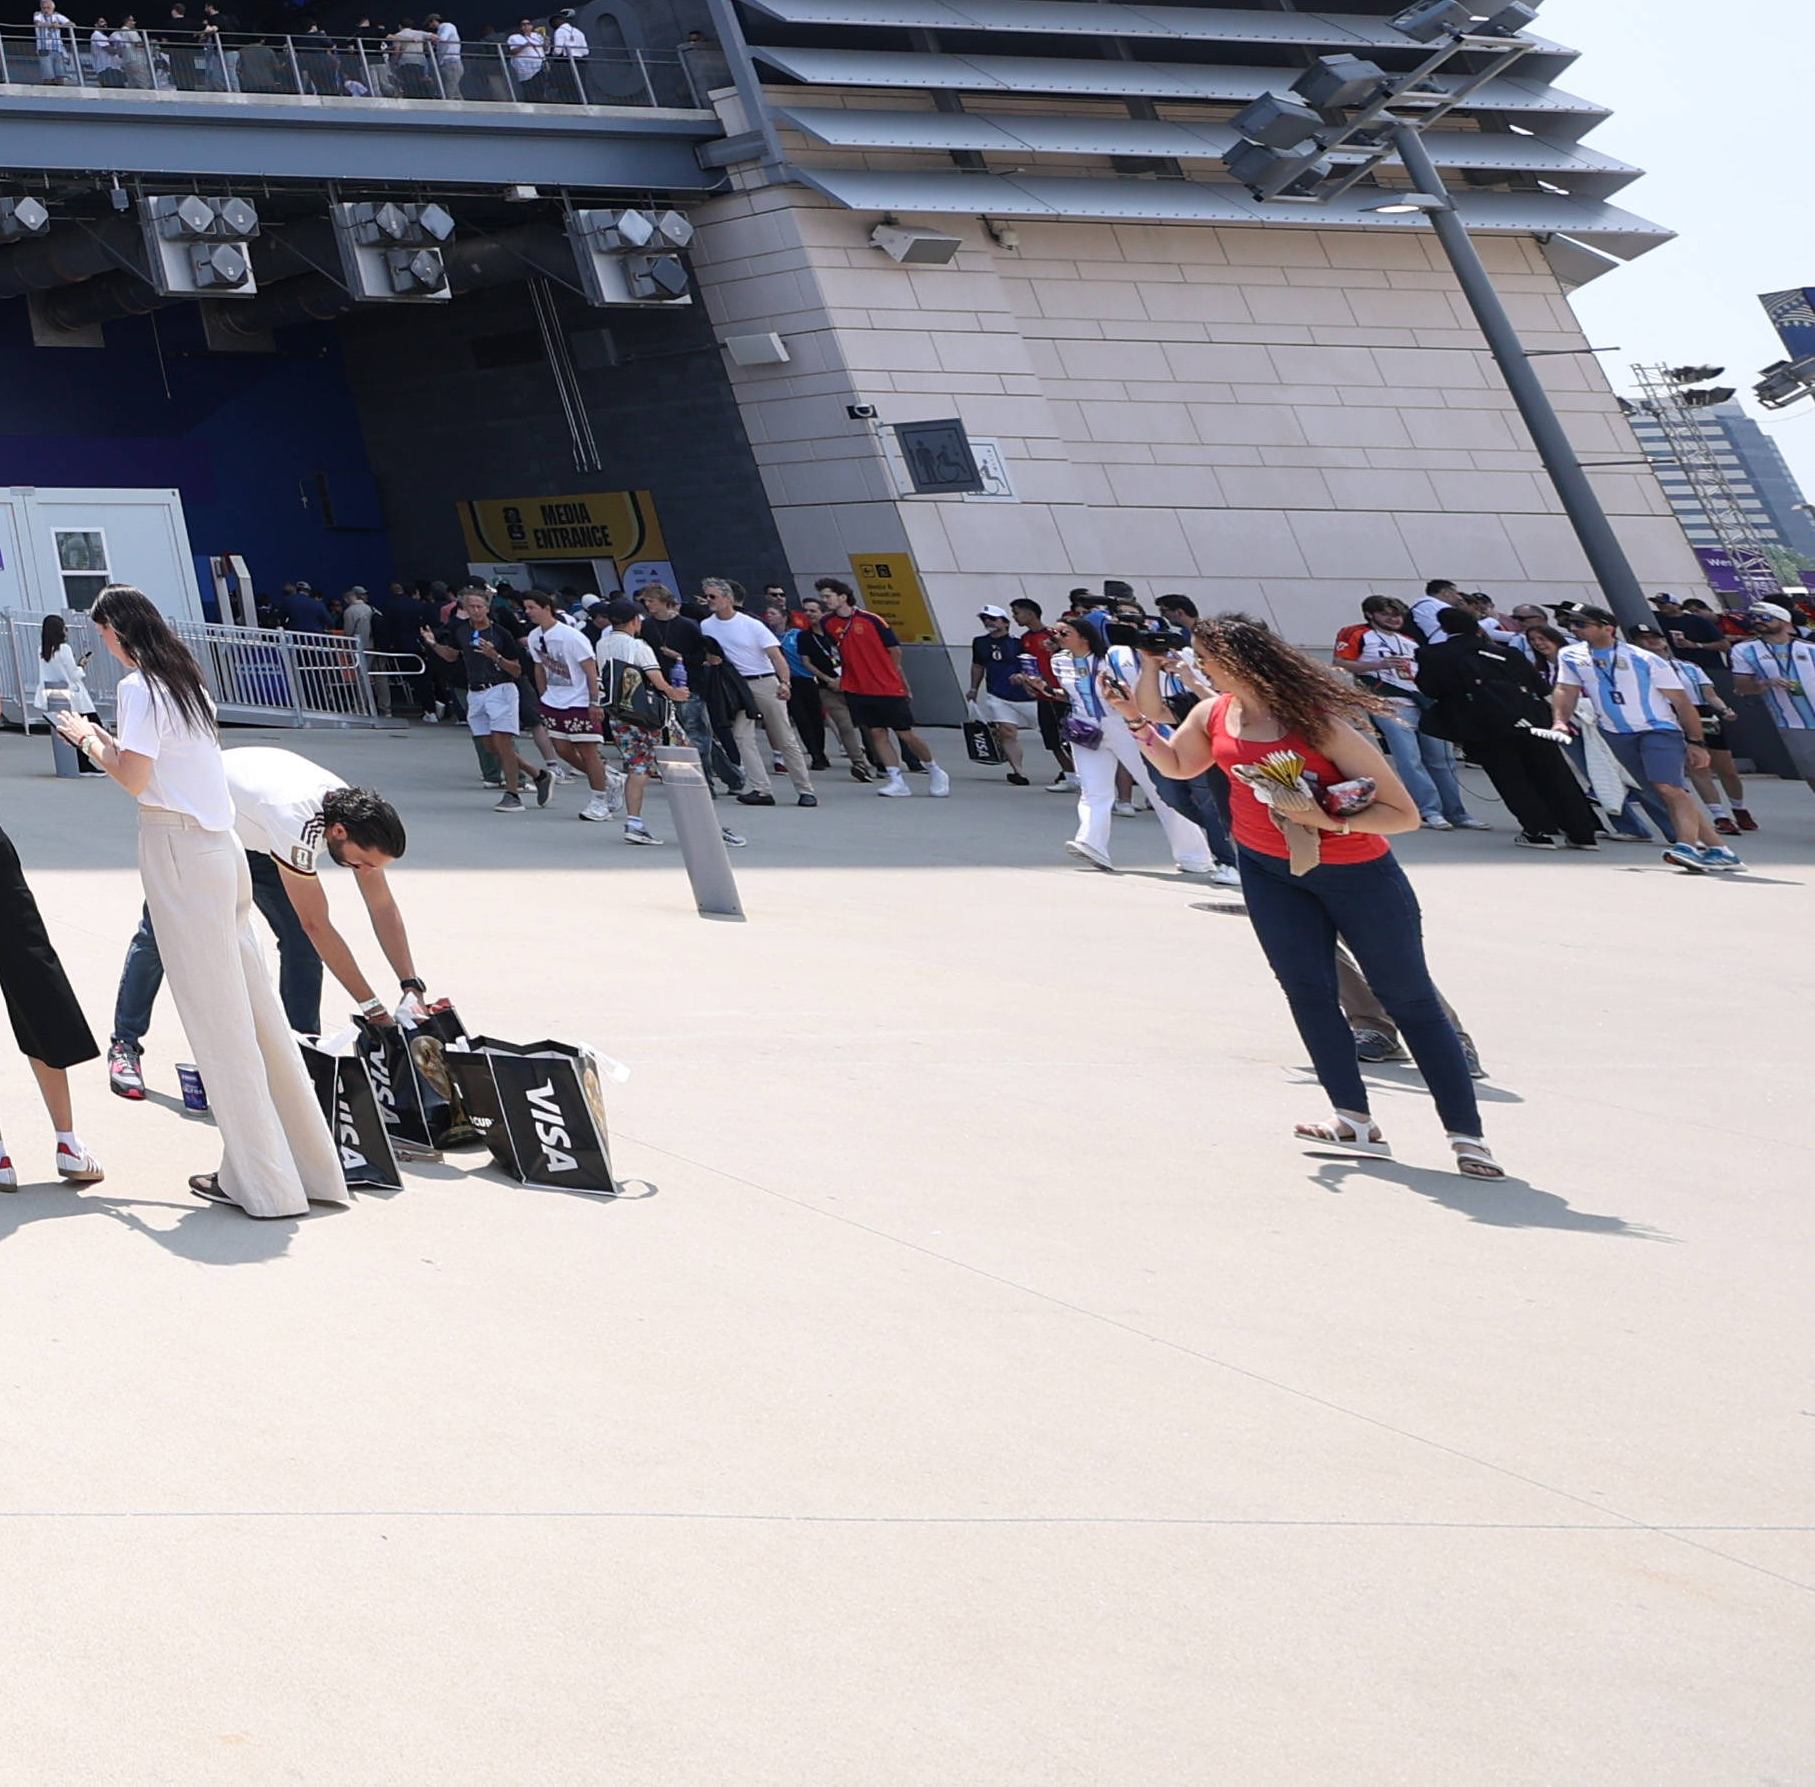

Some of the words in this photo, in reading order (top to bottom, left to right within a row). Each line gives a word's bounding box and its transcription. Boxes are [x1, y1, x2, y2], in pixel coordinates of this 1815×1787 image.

[540, 502, 592, 526] MEDIA
[533, 525, 613, 549] ENTRANCE
[974, 733, 990, 757] VISA
[526, 1077, 579, 1172] VISA
